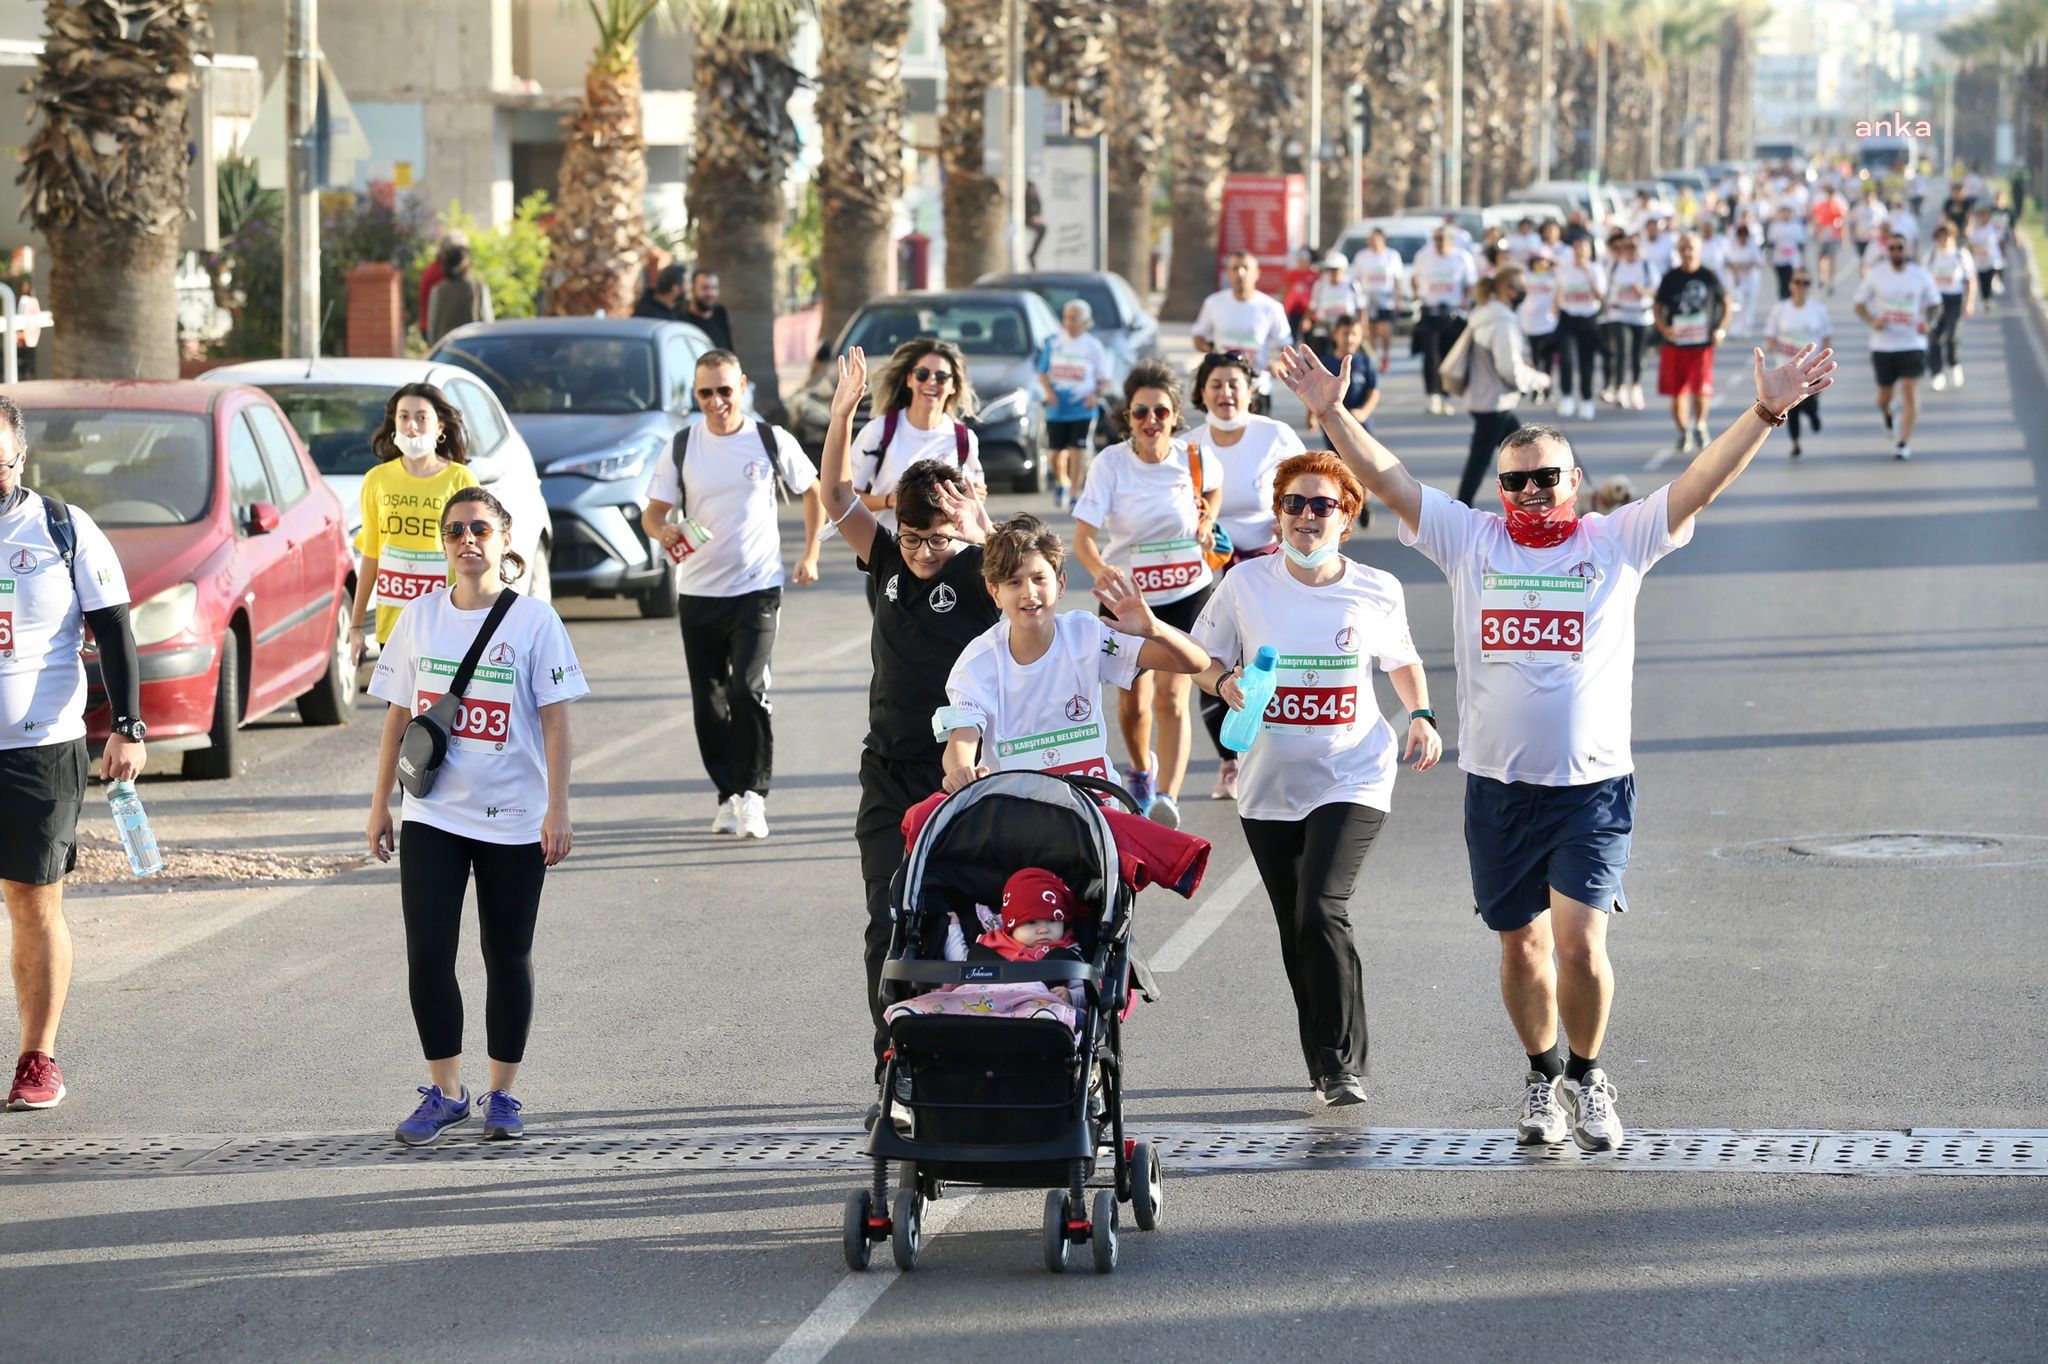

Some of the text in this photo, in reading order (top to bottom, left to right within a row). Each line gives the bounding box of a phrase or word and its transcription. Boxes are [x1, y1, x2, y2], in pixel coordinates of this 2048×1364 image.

[1134, 565, 1201, 590] 36592
[1497, 578, 1584, 589] KARŞIYAKA BELEDİYESİ
[1483, 616, 1582, 647] 36543
[1278, 656, 1357, 668] KARŞIYAKA BELEDİYESİ
[1264, 693, 1355, 720] 36545
[1014, 725, 1098, 751] KARŞIYAKA BELEDİYESİ
[965, 966, 993, 980] Johnson
